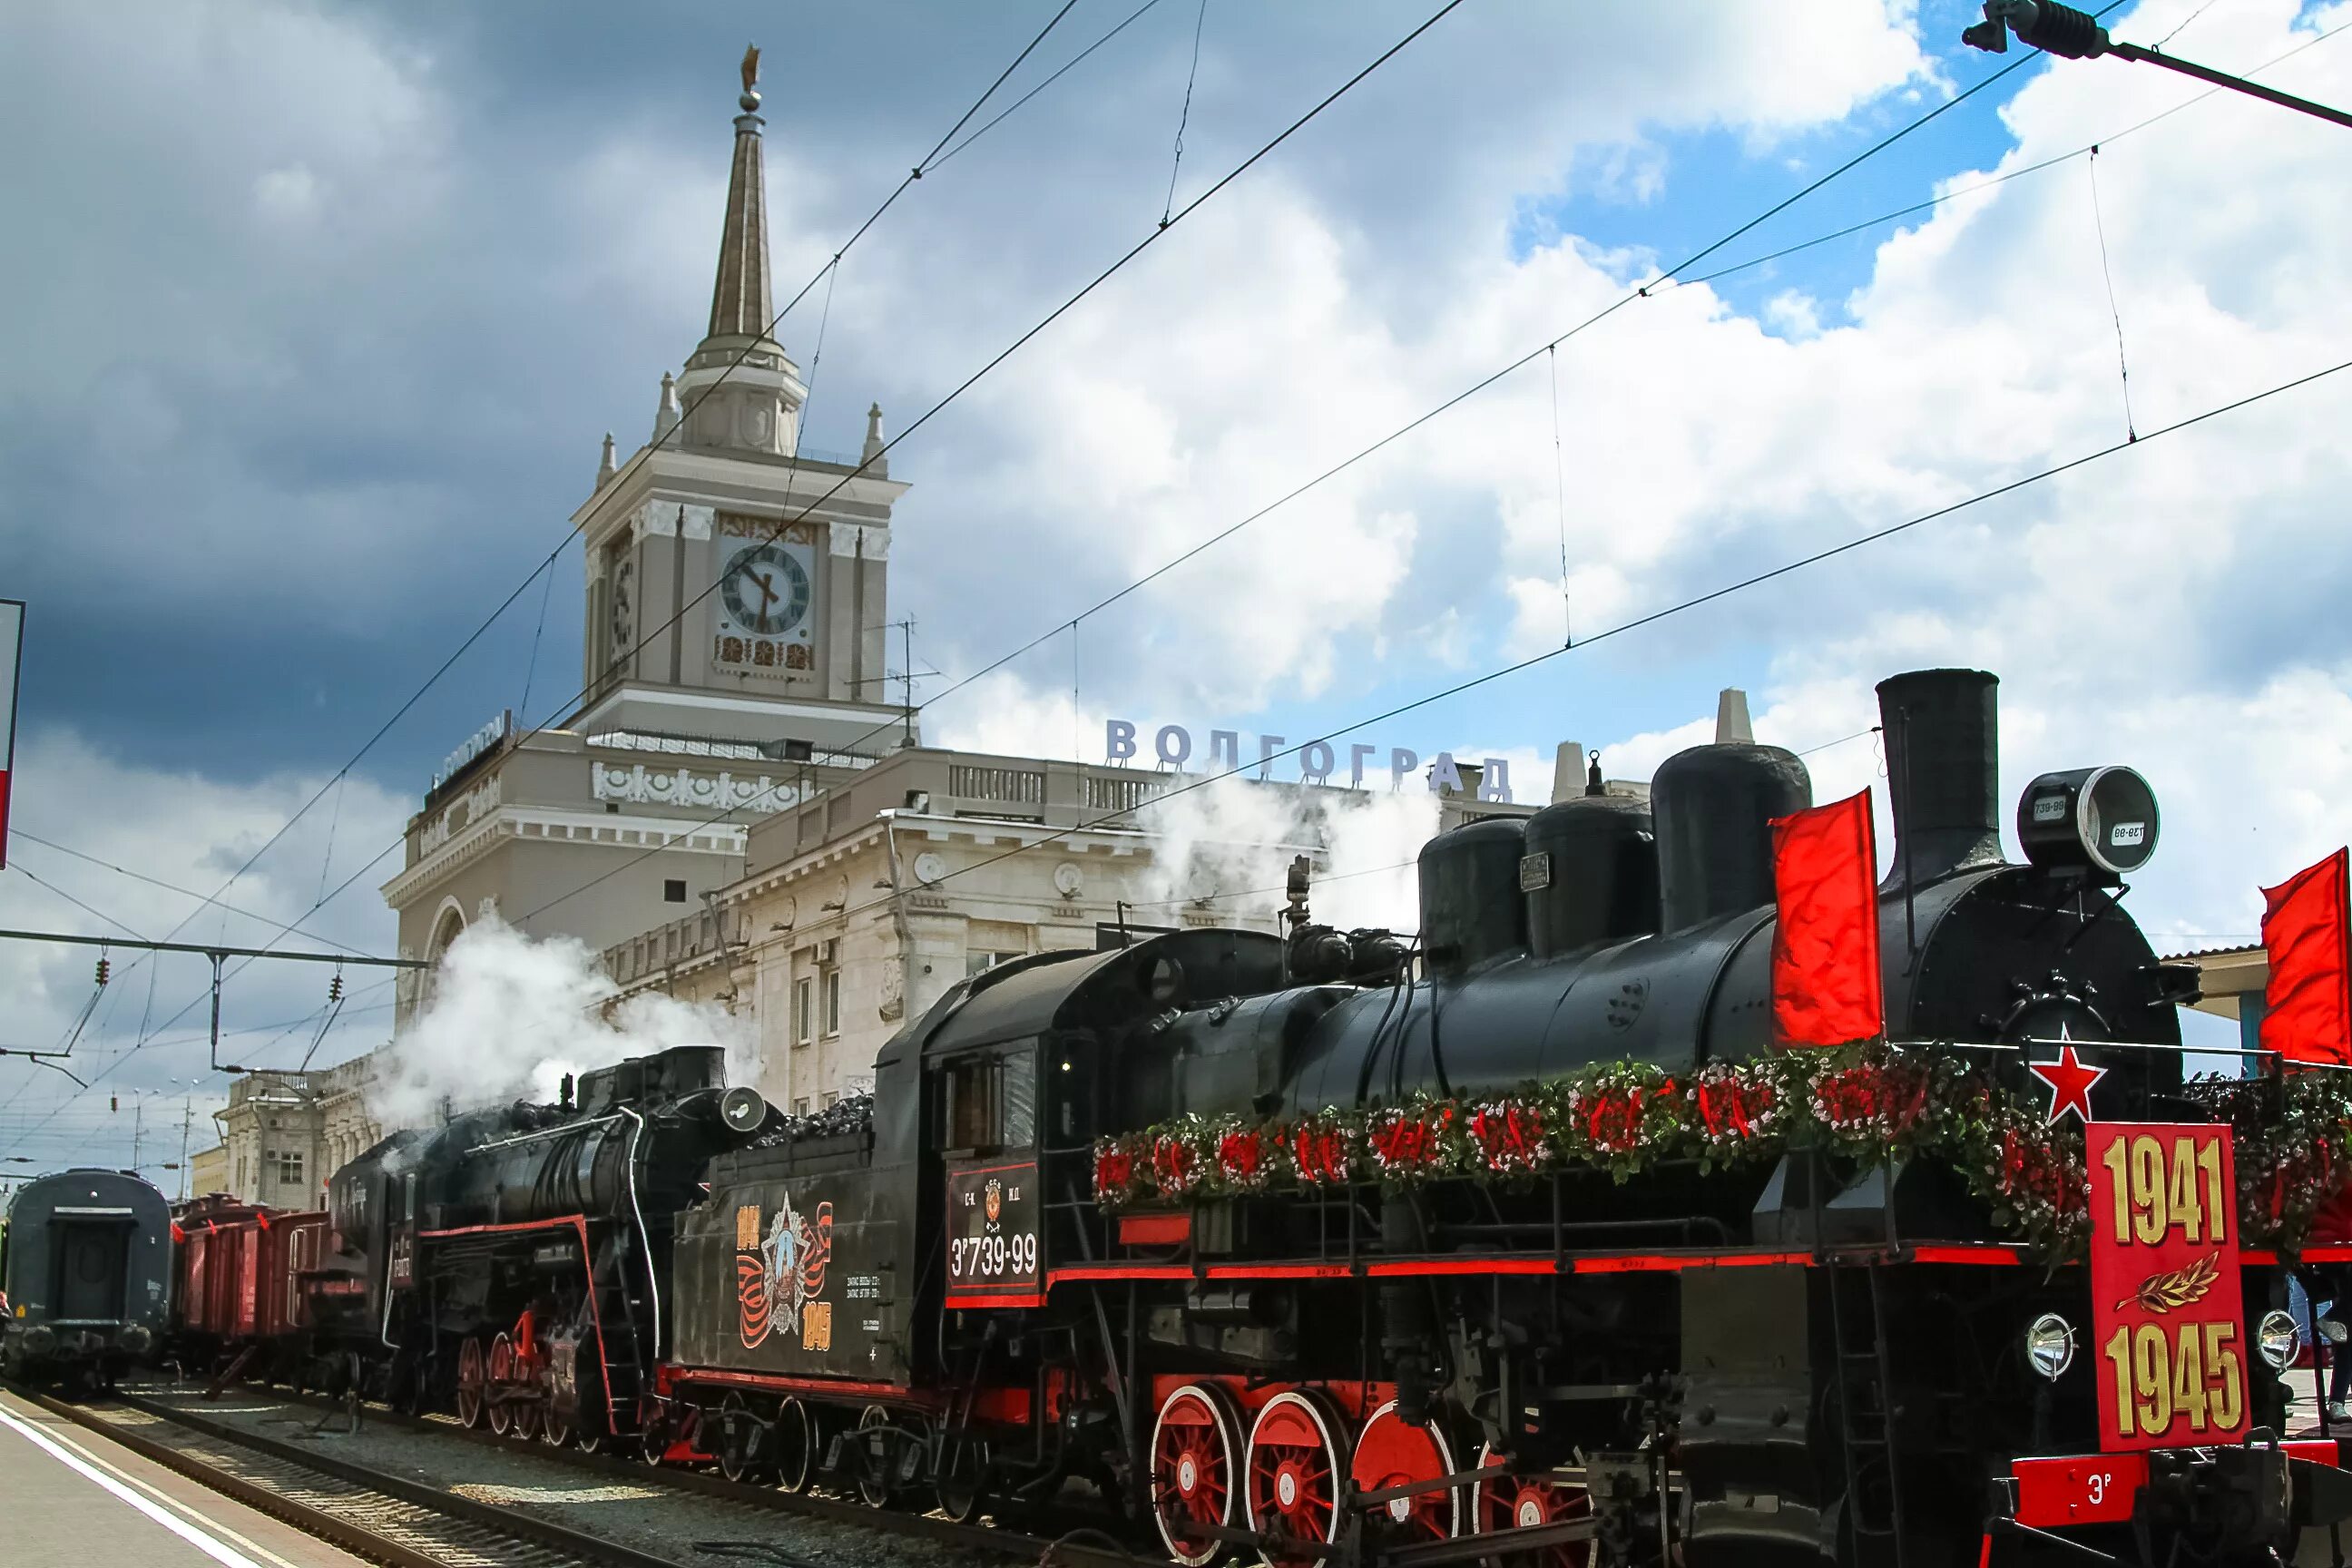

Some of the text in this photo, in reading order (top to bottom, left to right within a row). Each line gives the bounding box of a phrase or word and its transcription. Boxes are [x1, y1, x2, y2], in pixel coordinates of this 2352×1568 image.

[1105, 719, 1514, 803] ВОЛГОГРАД
[2102, 1132, 2227, 1246] 1941
[2105, 1321, 2243, 1437] 1945
